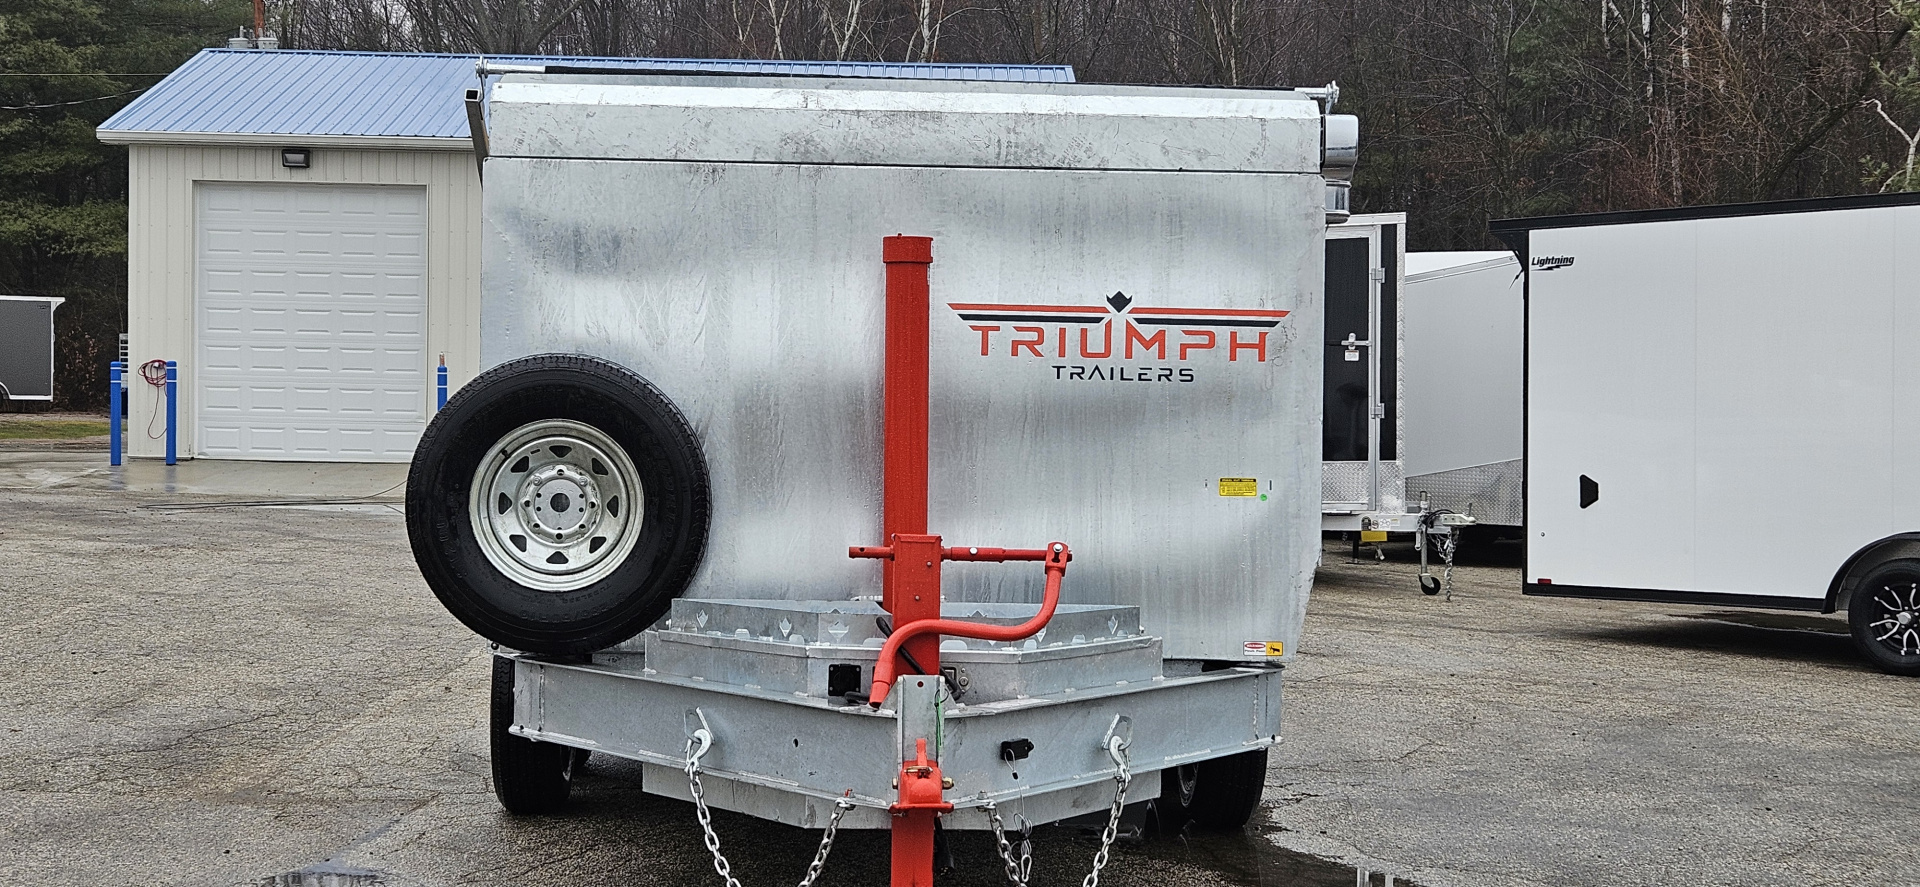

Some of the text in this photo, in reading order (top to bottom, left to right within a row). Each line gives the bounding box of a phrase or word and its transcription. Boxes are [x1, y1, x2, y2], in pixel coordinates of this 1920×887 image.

[1531, 255, 1575, 267] Lightning
[968, 318, 1270, 362] TRIUMPH
[1051, 365, 1195, 383] TRAILERS
